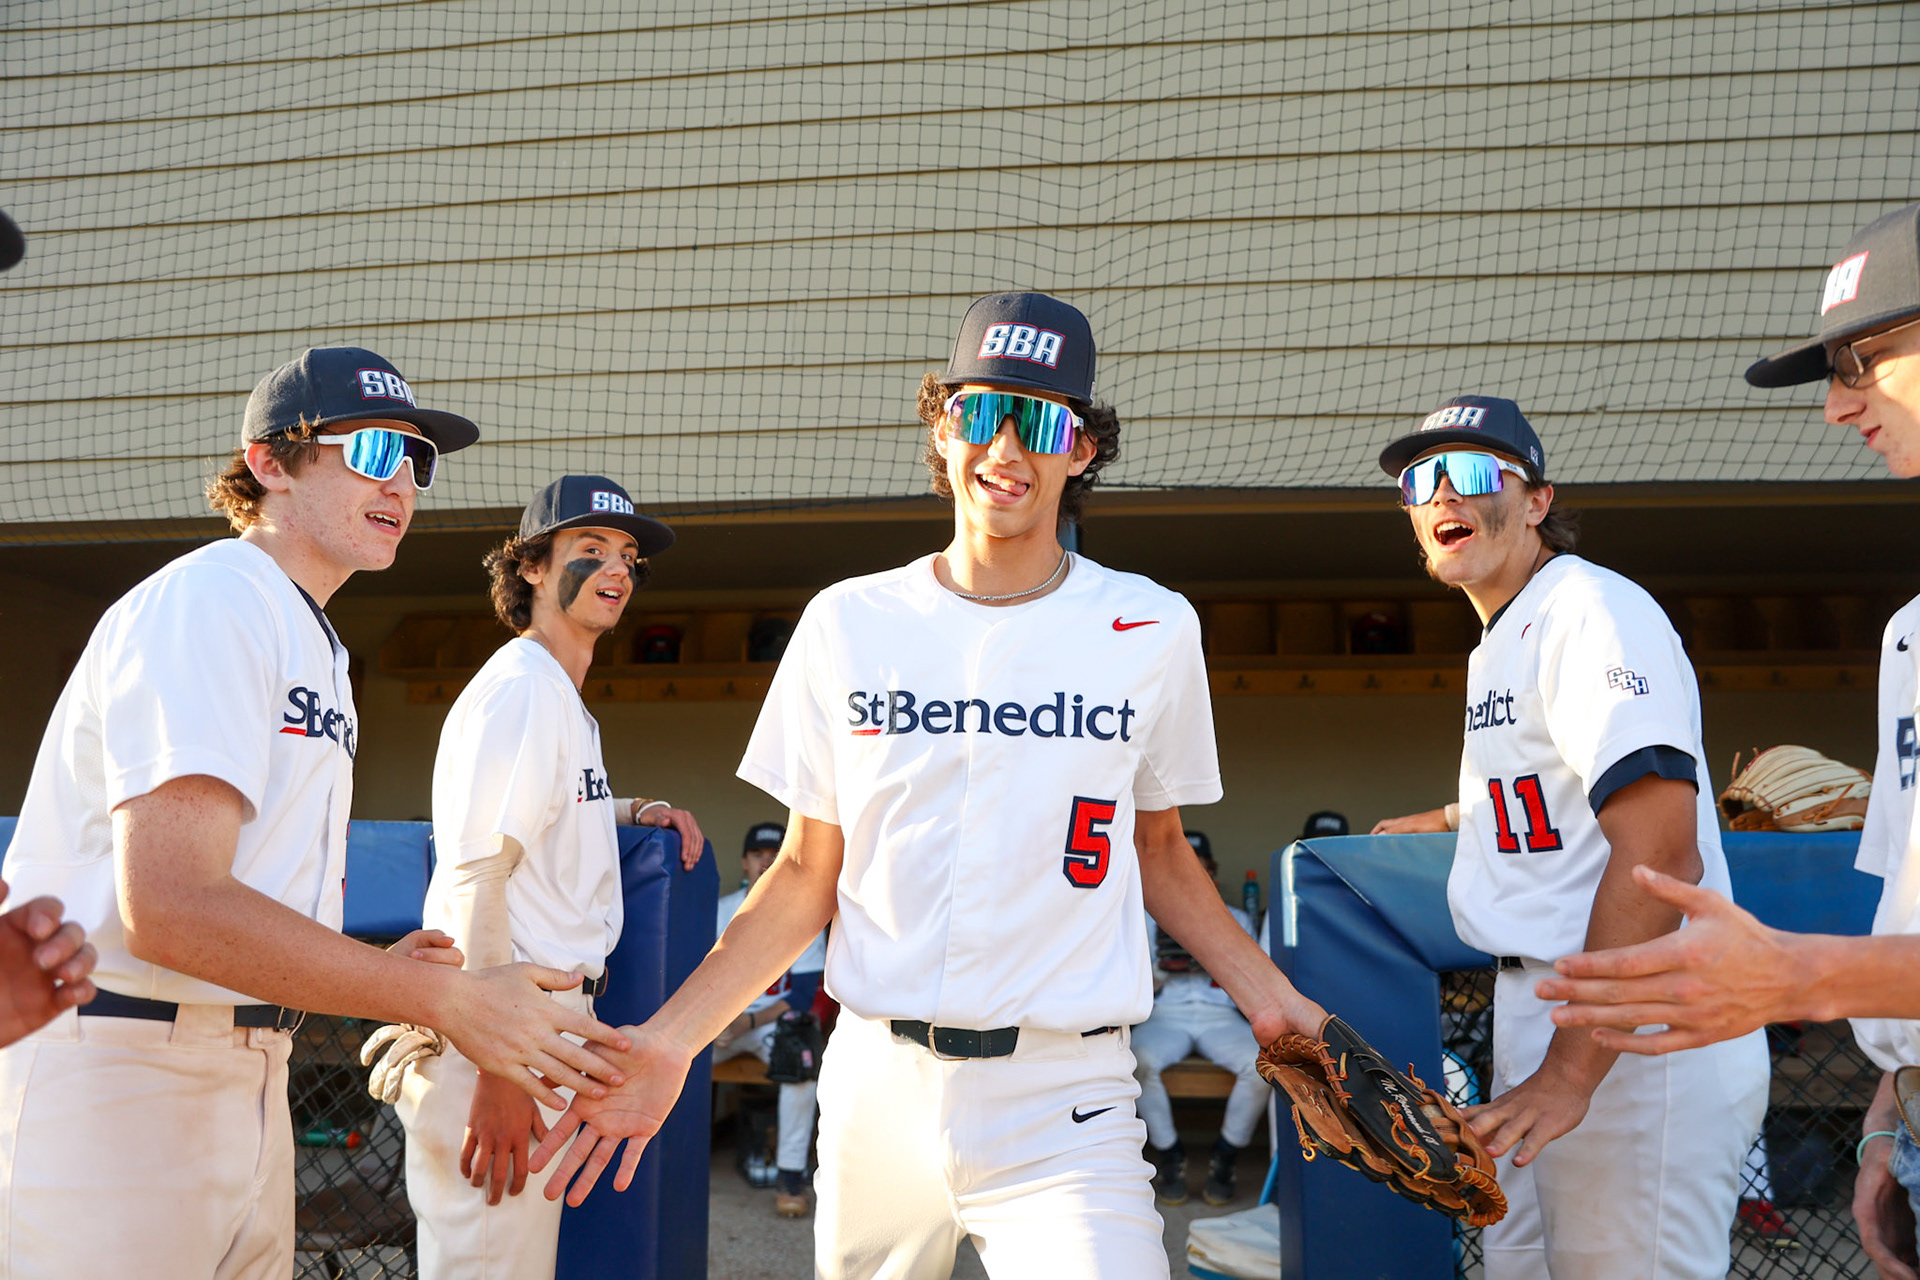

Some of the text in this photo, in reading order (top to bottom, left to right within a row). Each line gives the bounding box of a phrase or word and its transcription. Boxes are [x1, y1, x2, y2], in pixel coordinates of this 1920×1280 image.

[979, 322, 1066, 369] SBA
[1607, 667, 1650, 695] SBA
[1062, 795, 1117, 889] 5
[1488, 773, 1564, 853] 11
